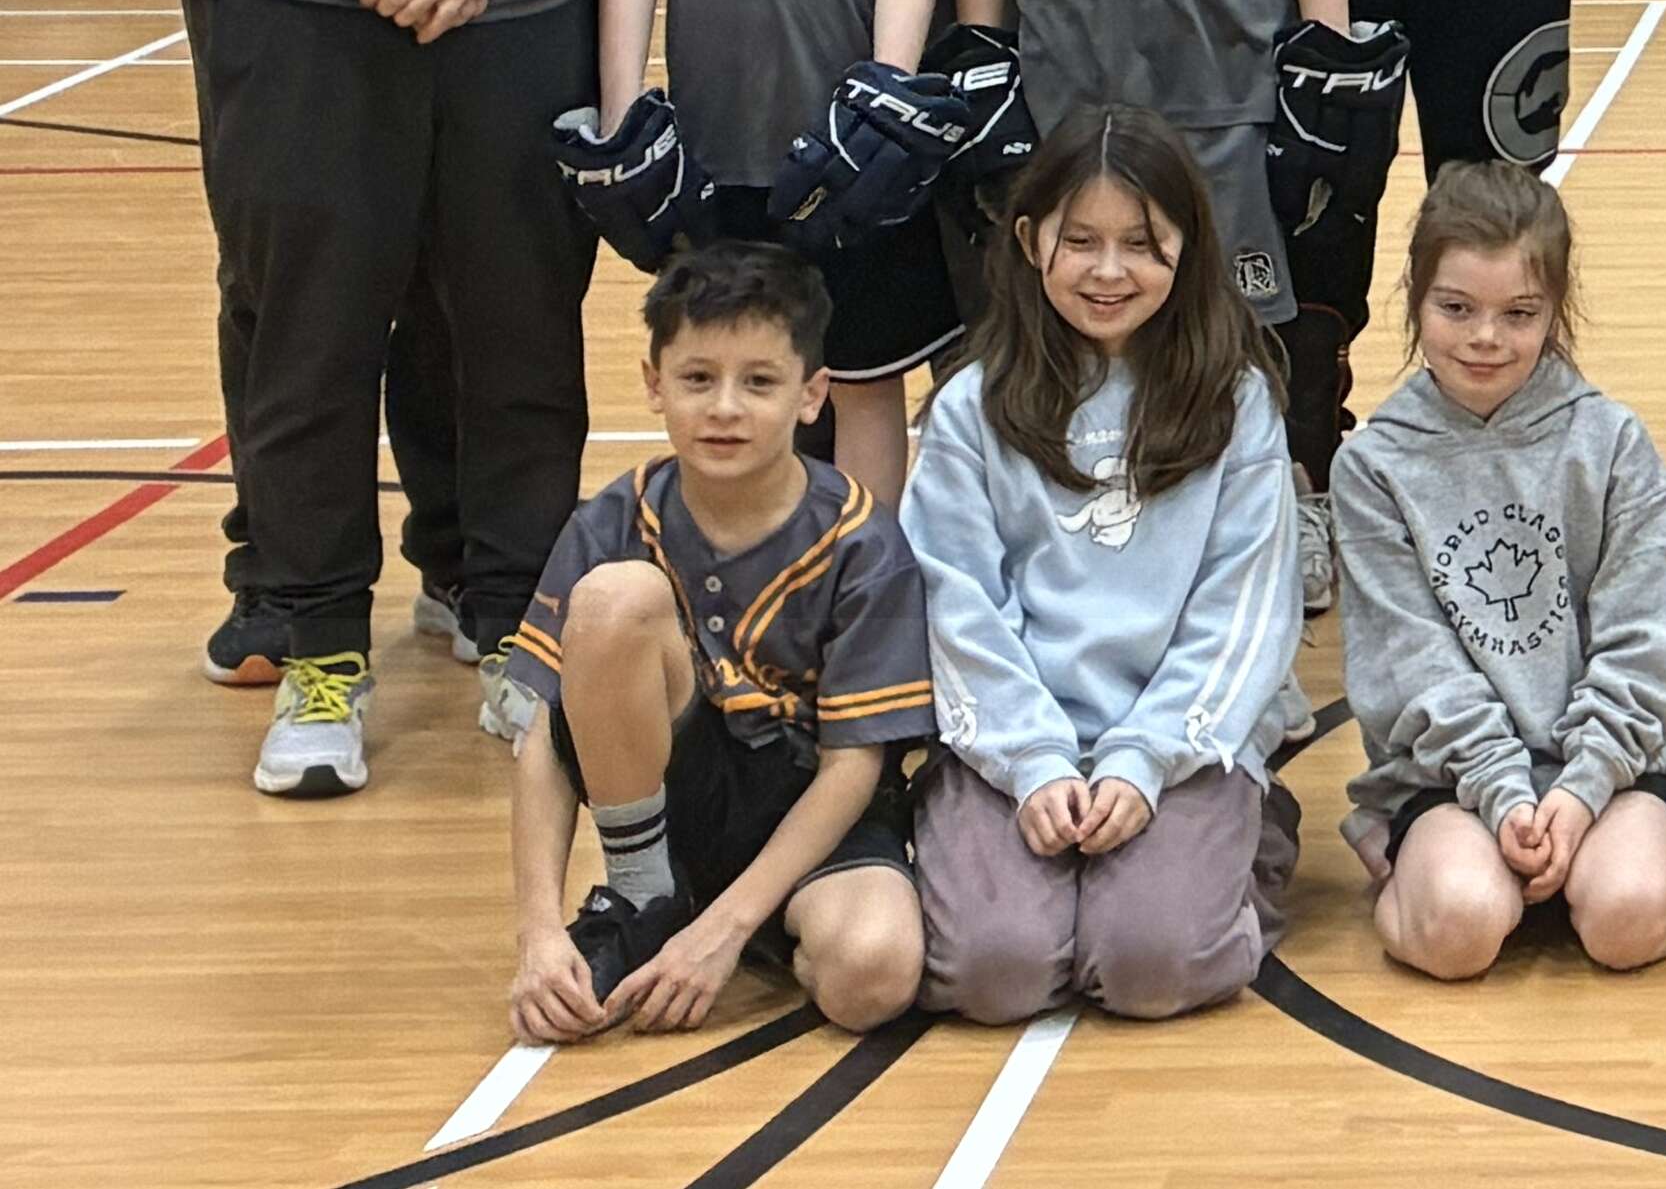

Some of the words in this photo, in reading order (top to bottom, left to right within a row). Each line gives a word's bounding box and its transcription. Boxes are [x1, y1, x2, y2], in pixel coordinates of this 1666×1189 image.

[1283, 54, 1408, 94] TRU
[556, 123, 680, 187] TRUE
[1431, 509, 1490, 590] WORLD
